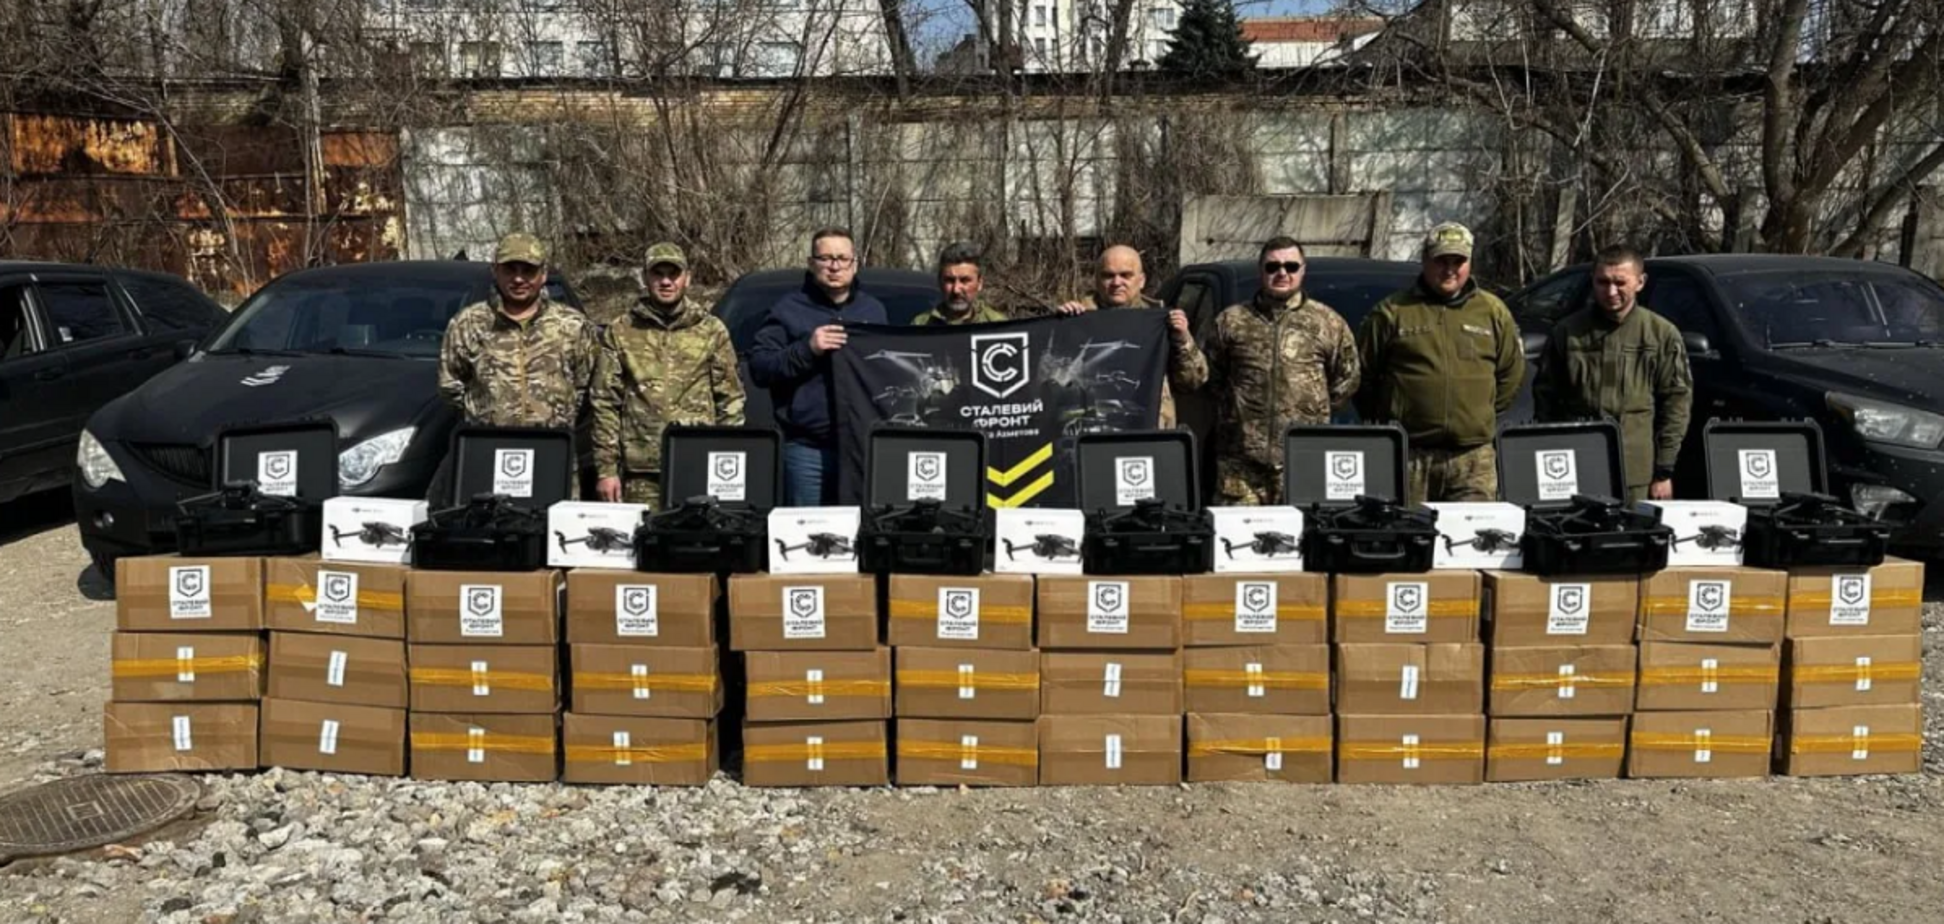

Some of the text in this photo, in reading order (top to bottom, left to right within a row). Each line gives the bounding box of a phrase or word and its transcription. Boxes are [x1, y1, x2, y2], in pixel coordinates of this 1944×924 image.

[982, 342, 1018, 382] С
[960, 399, 1043, 417] СТАЛЕВИЙ
[973, 415, 1031, 428] ФРОНТ
